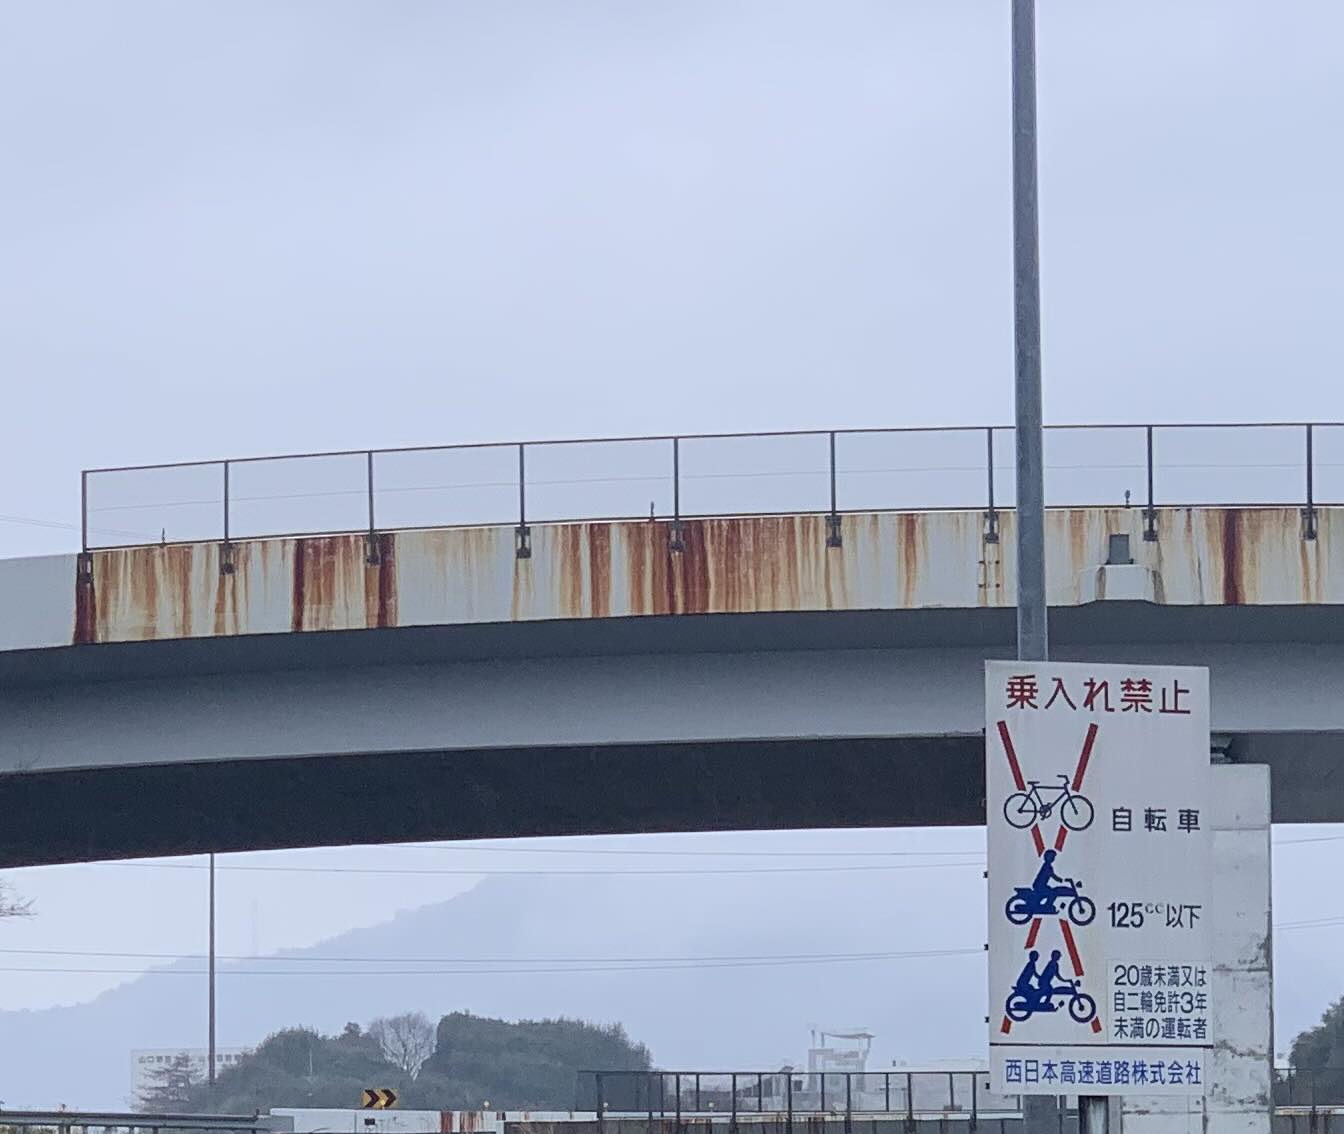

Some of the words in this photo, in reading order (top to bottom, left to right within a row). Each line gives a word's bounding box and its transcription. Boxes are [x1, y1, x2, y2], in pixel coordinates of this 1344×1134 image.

[1006, 674, 1191, 715] 乗入れ禁止
[1112, 806, 1201, 833] 自転車
[1114, 964, 1207, 987] 20歳未満又は
[1114, 990, 1207, 1013] 自二輪免許3年
[1114, 1016, 1207, 1039] 未満の運転者
[1005, 1059, 1202, 1085] 西日本高速道路株式会社
